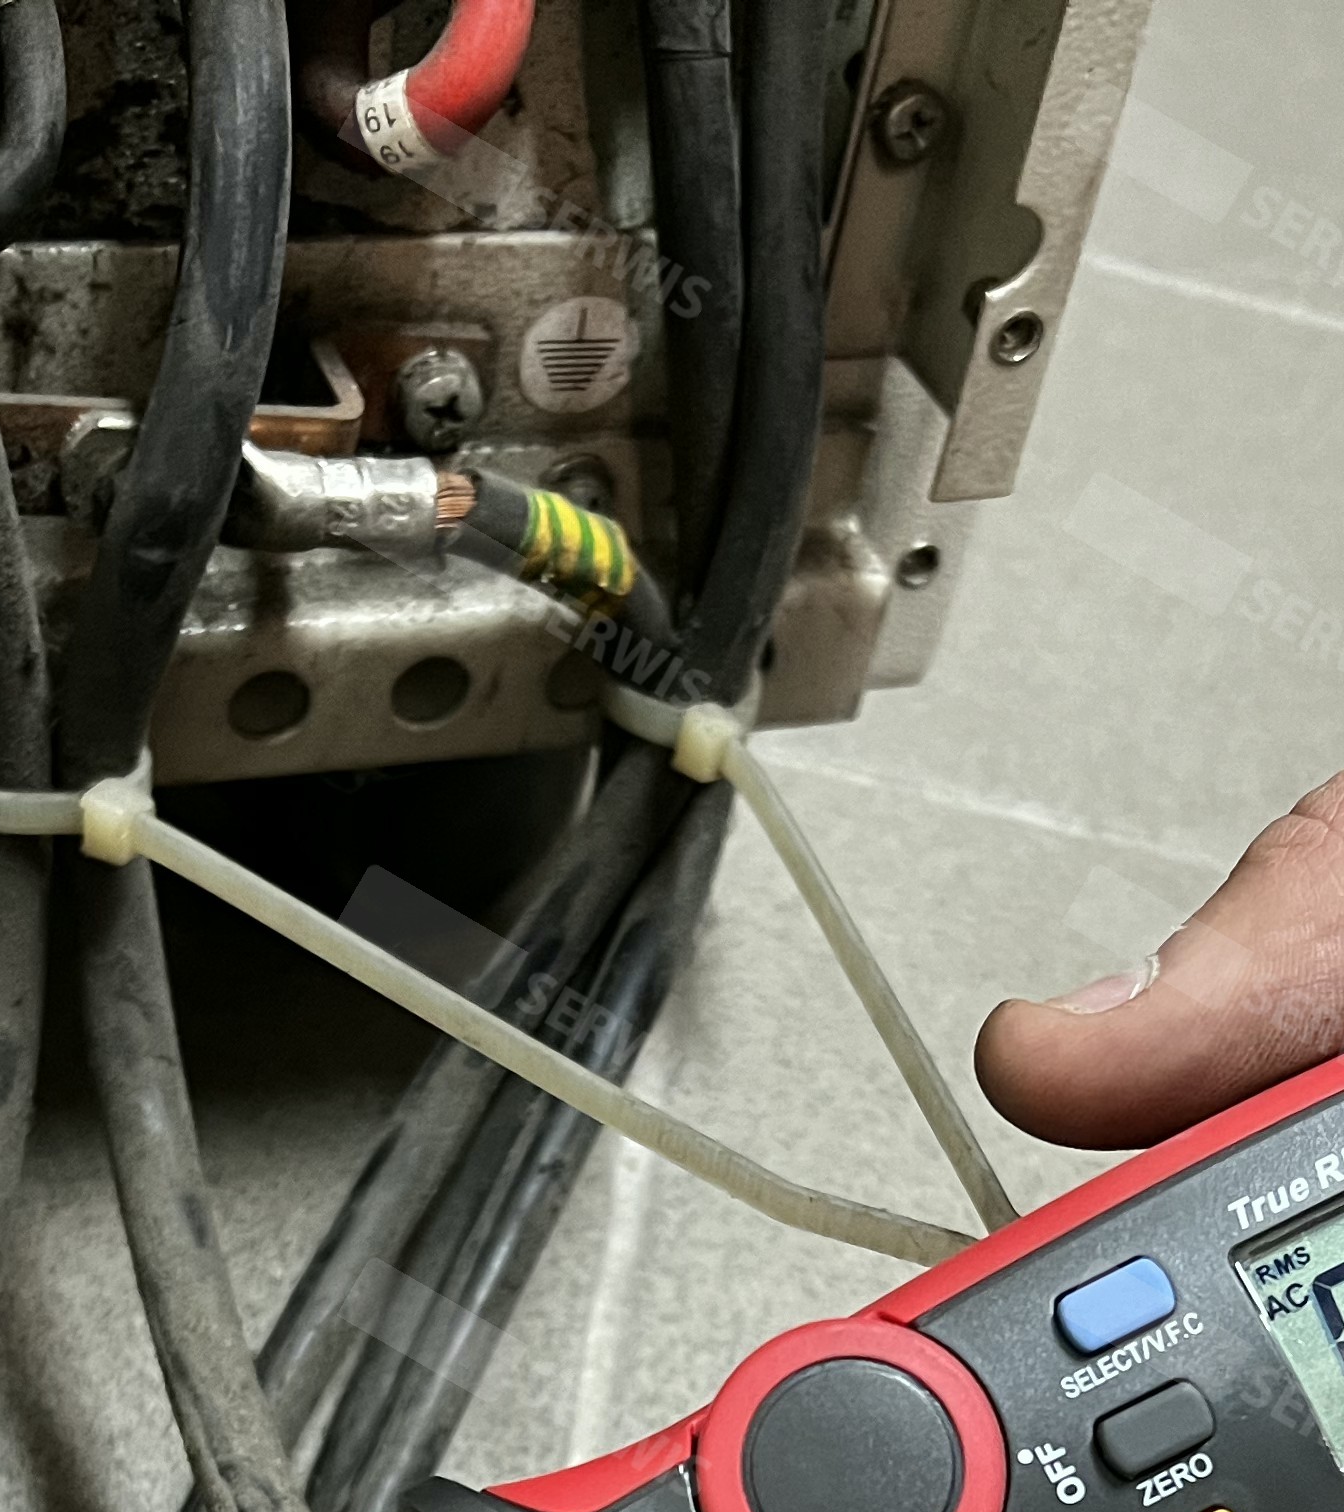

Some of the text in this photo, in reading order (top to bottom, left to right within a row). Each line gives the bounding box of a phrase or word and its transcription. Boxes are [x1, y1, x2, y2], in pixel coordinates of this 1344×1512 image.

[1227, 1177, 1310, 1230] True
[1255, 1247, 1311, 1285] RMS
[1266, 1284, 1310, 1321] AC
[1060, 1312, 1204, 1399] SELECT/V.F.C
[1034, 1443, 1086, 1505] OFF
[1135, 1453, 1214, 1507] ZERO
